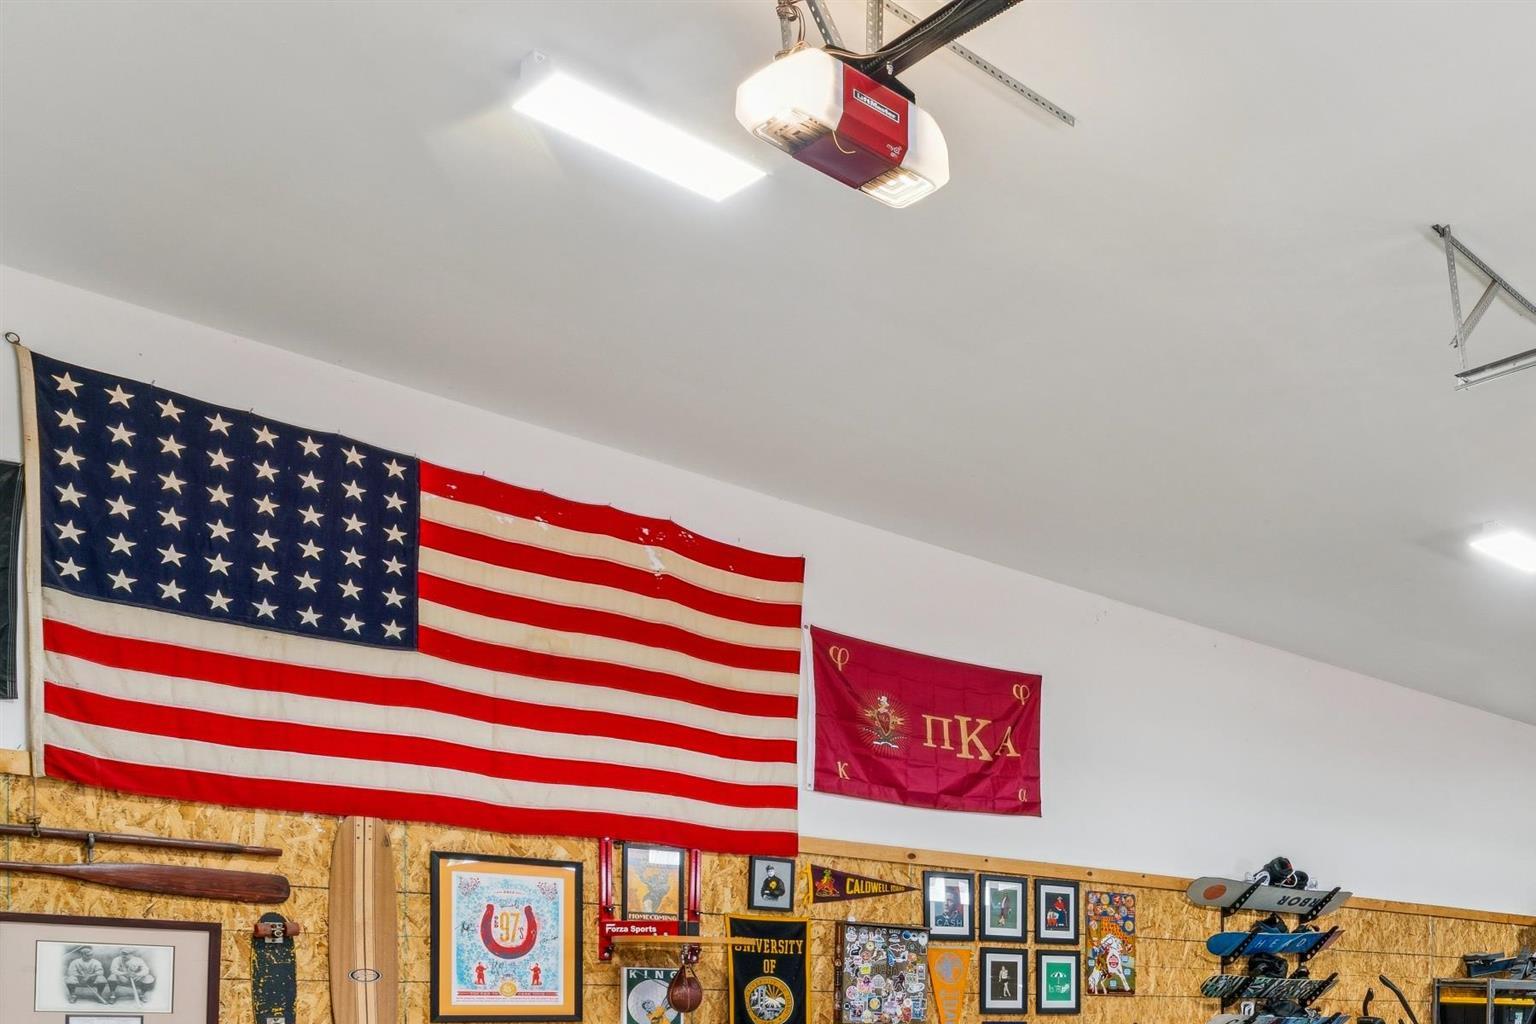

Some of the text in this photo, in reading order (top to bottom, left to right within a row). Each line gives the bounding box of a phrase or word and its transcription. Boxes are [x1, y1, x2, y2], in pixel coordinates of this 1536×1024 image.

[1277, 895, 1321, 908] RBOR
[605, 923, 657, 934] Forza Sports
[936, 919, 963, 928] CASH
[763, 959, 776, 974] OF
